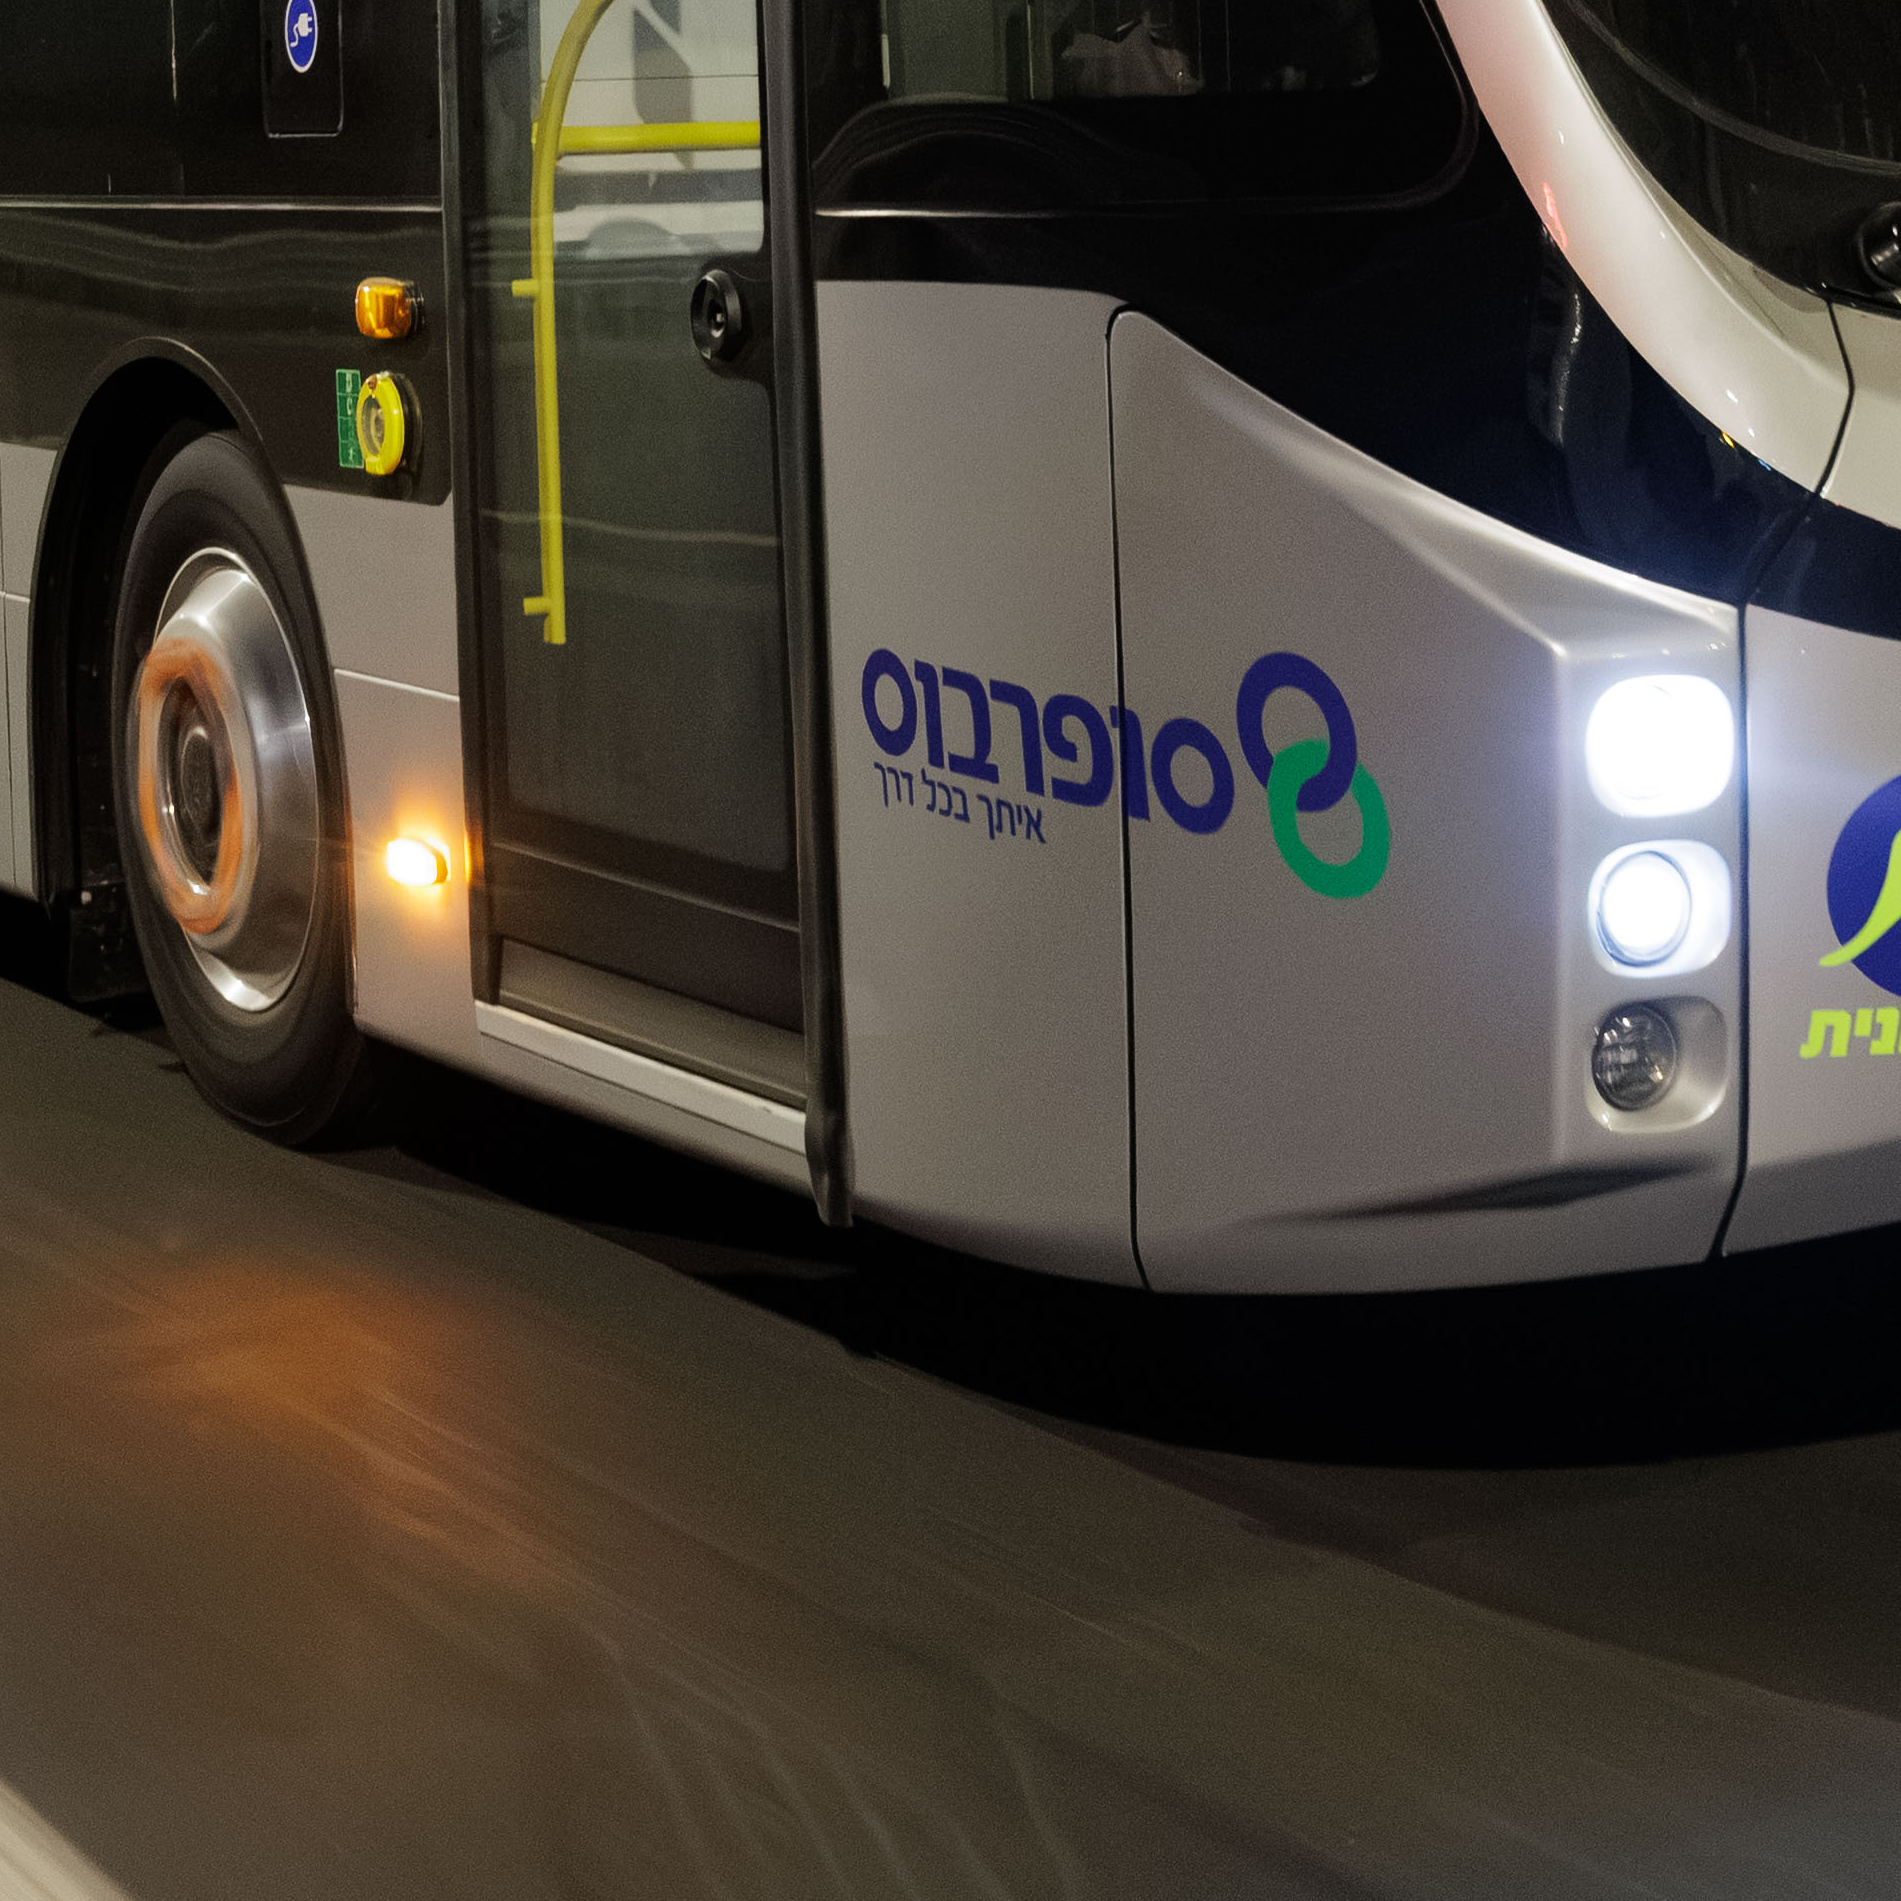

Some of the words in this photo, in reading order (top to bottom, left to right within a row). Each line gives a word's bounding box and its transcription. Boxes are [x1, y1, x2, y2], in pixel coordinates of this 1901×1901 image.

[861, 648, 1235, 834] סופרבוס
[874, 762, 915, 807] דרך
[921, 768, 971, 823] בכל
[977, 793, 1047, 844] איתך
